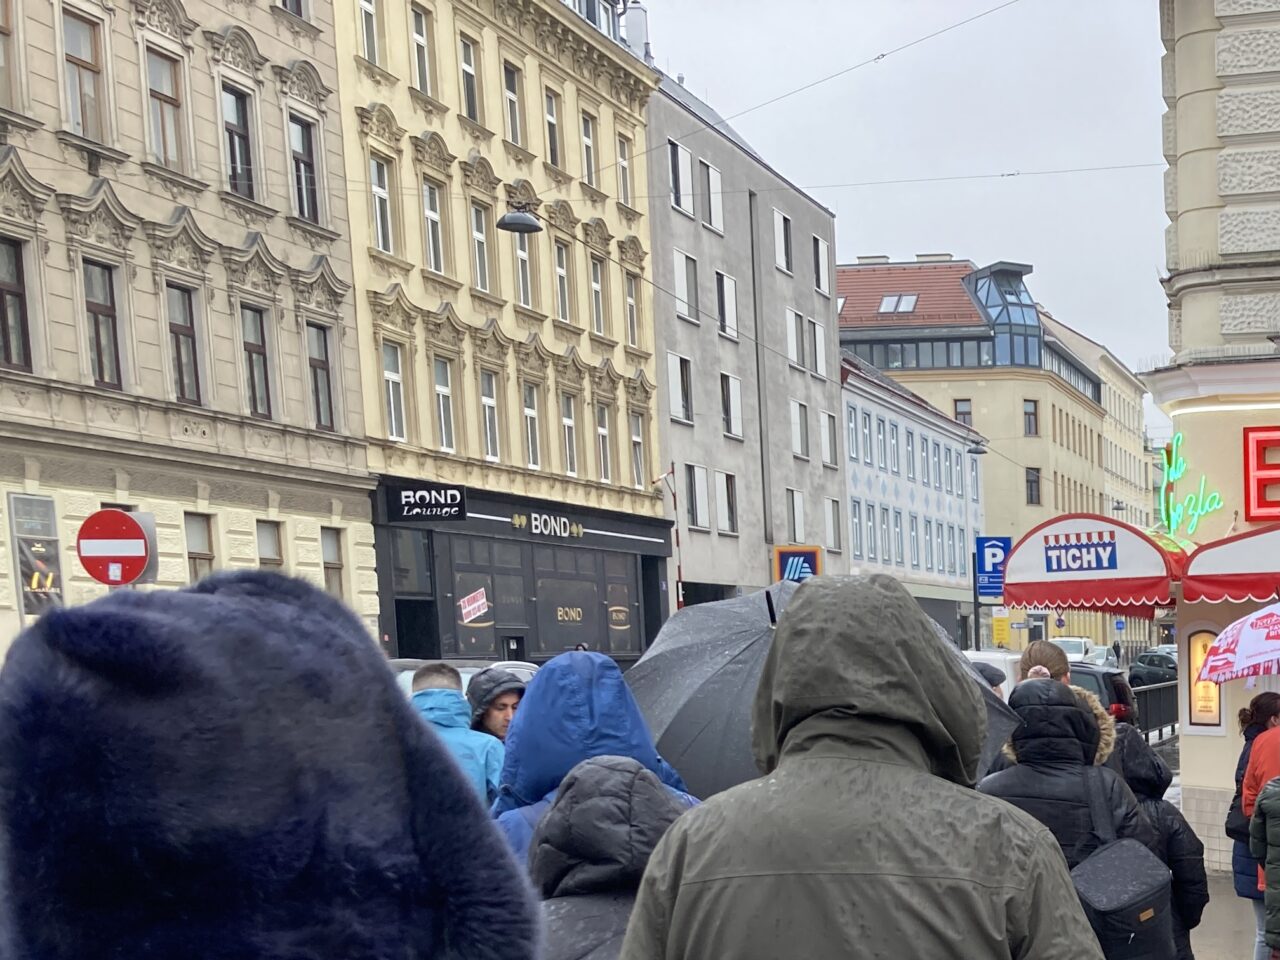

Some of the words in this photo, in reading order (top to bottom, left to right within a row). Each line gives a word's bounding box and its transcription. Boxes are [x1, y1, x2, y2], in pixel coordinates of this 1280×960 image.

[401, 490, 461, 504] BOND
[402, 506, 459, 517] Lounge
[531, 513, 570, 537] BOND
[1047, 546, 1113, 570] TICHY
[557, 607, 582, 621] BOND
